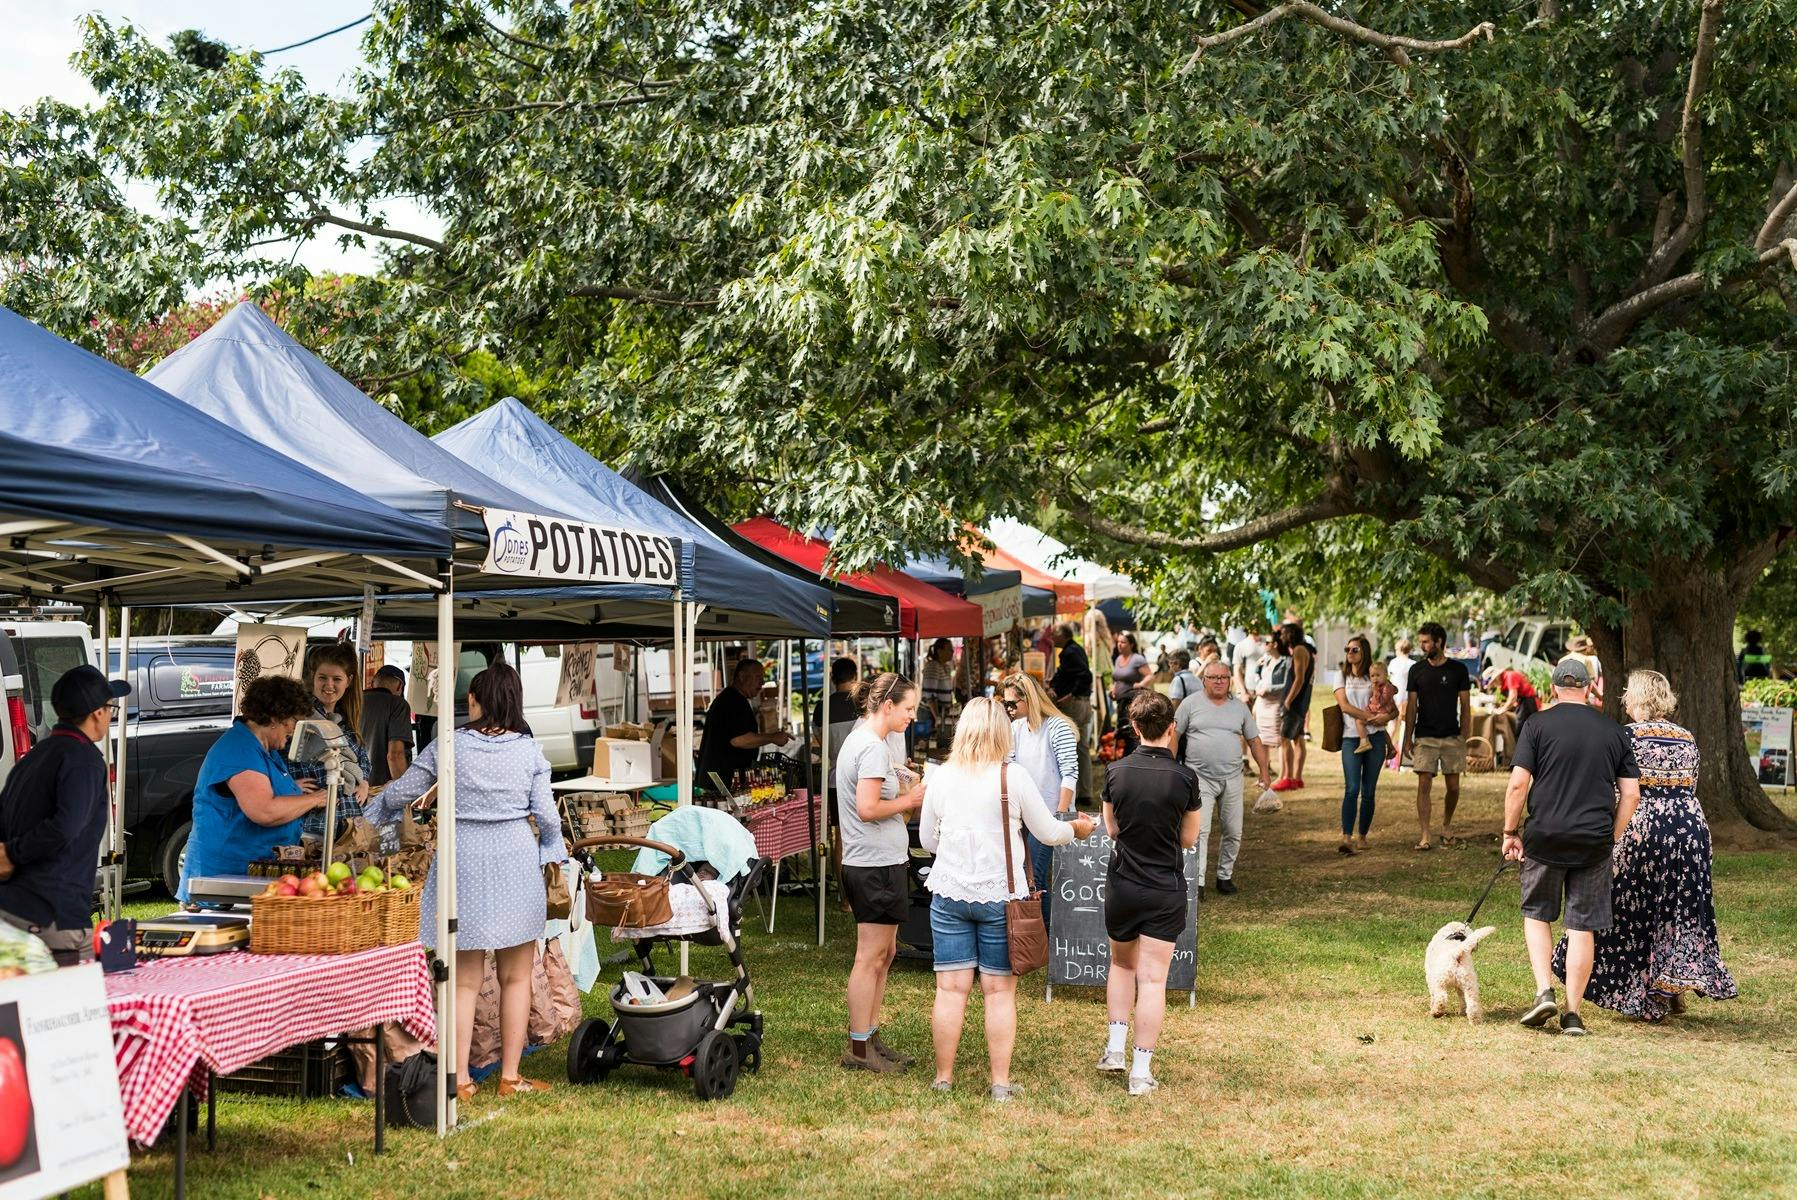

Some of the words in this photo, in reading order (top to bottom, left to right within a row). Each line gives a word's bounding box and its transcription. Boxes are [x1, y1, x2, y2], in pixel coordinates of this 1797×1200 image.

[498, 529, 529, 562] Jones
[527, 519, 673, 580] POTATOES
[503, 555, 526, 565] POTATOES
[1055, 937, 1112, 958] HILLG
